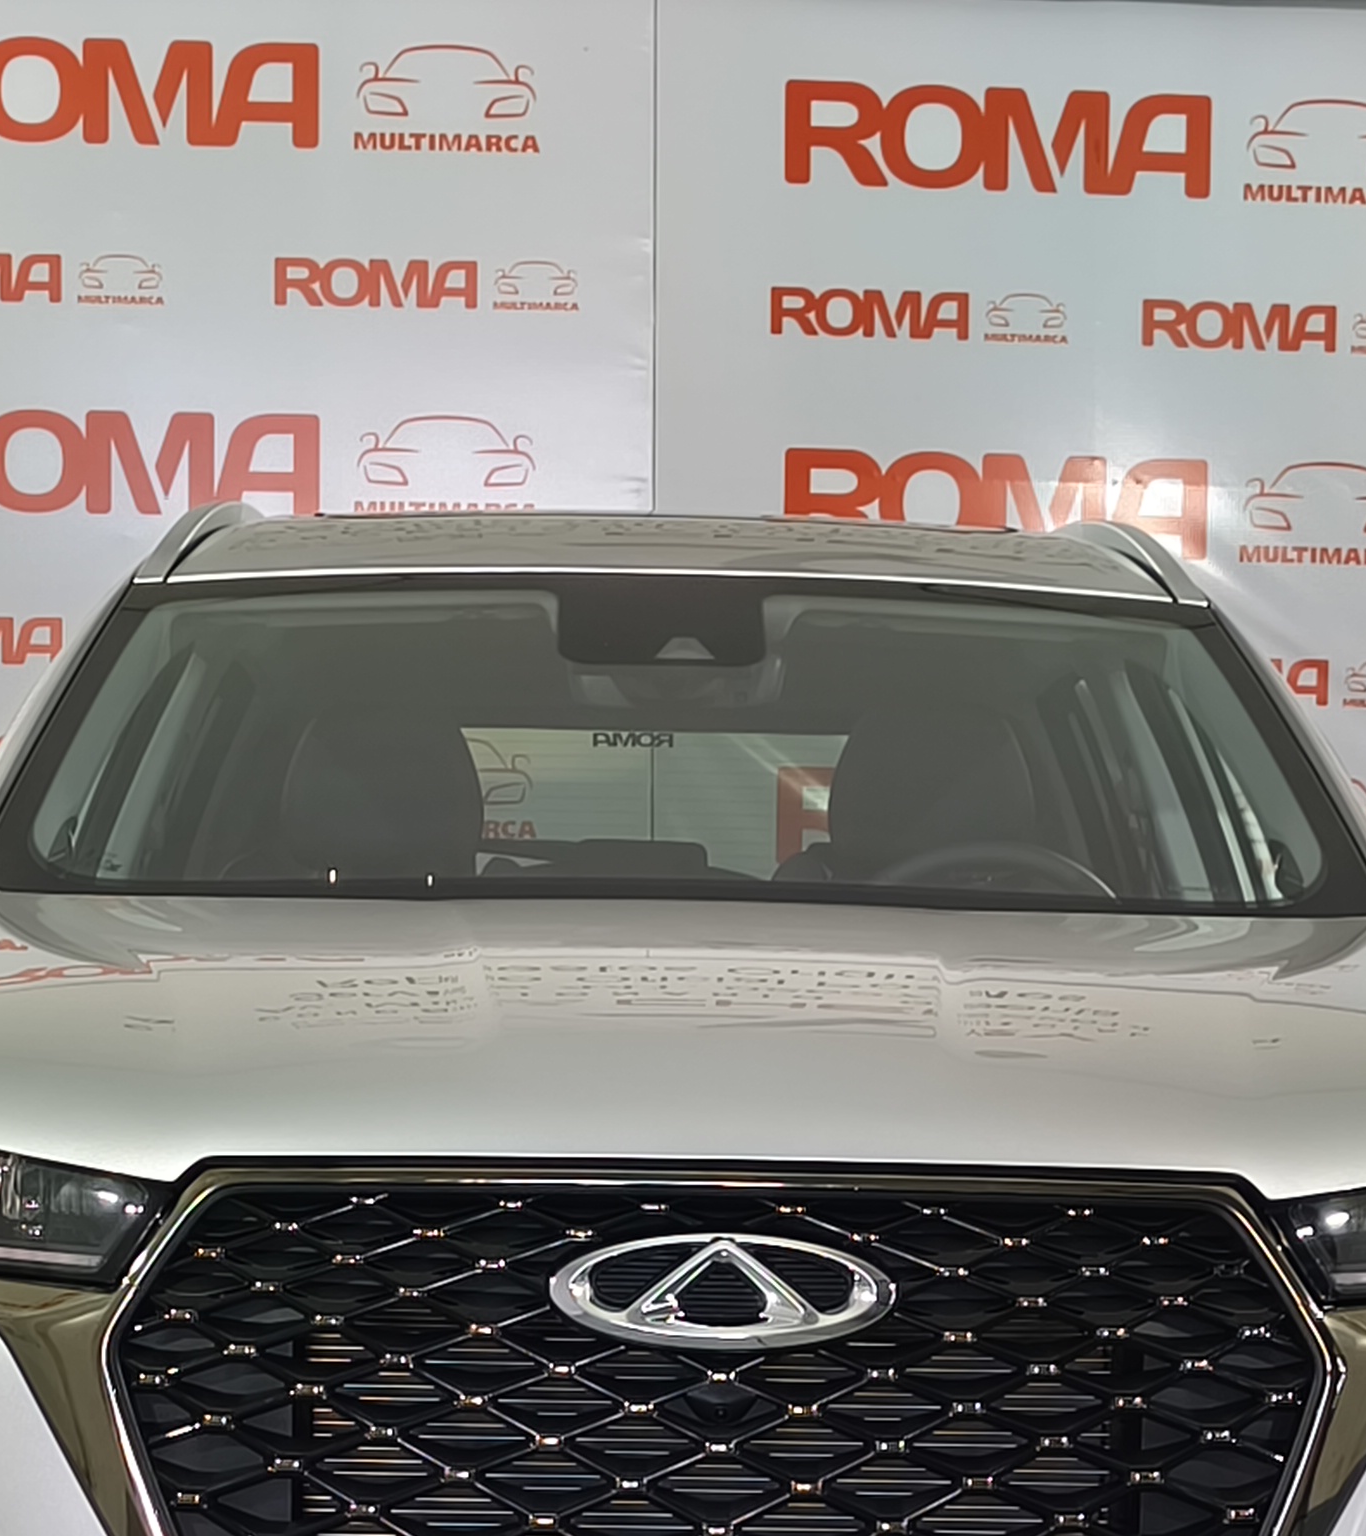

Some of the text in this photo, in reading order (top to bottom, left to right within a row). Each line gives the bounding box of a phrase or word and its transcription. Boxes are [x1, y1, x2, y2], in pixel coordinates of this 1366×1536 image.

[354, 133, 539, 155] MULTIMARCA
[784, 81, 1213, 199] ROMA
[275, 258, 478, 310] ROMA
[770, 288, 969, 341] ROMA
[1142, 300, 1338, 354] ROMA
[784, 449, 1207, 559] ROMA
